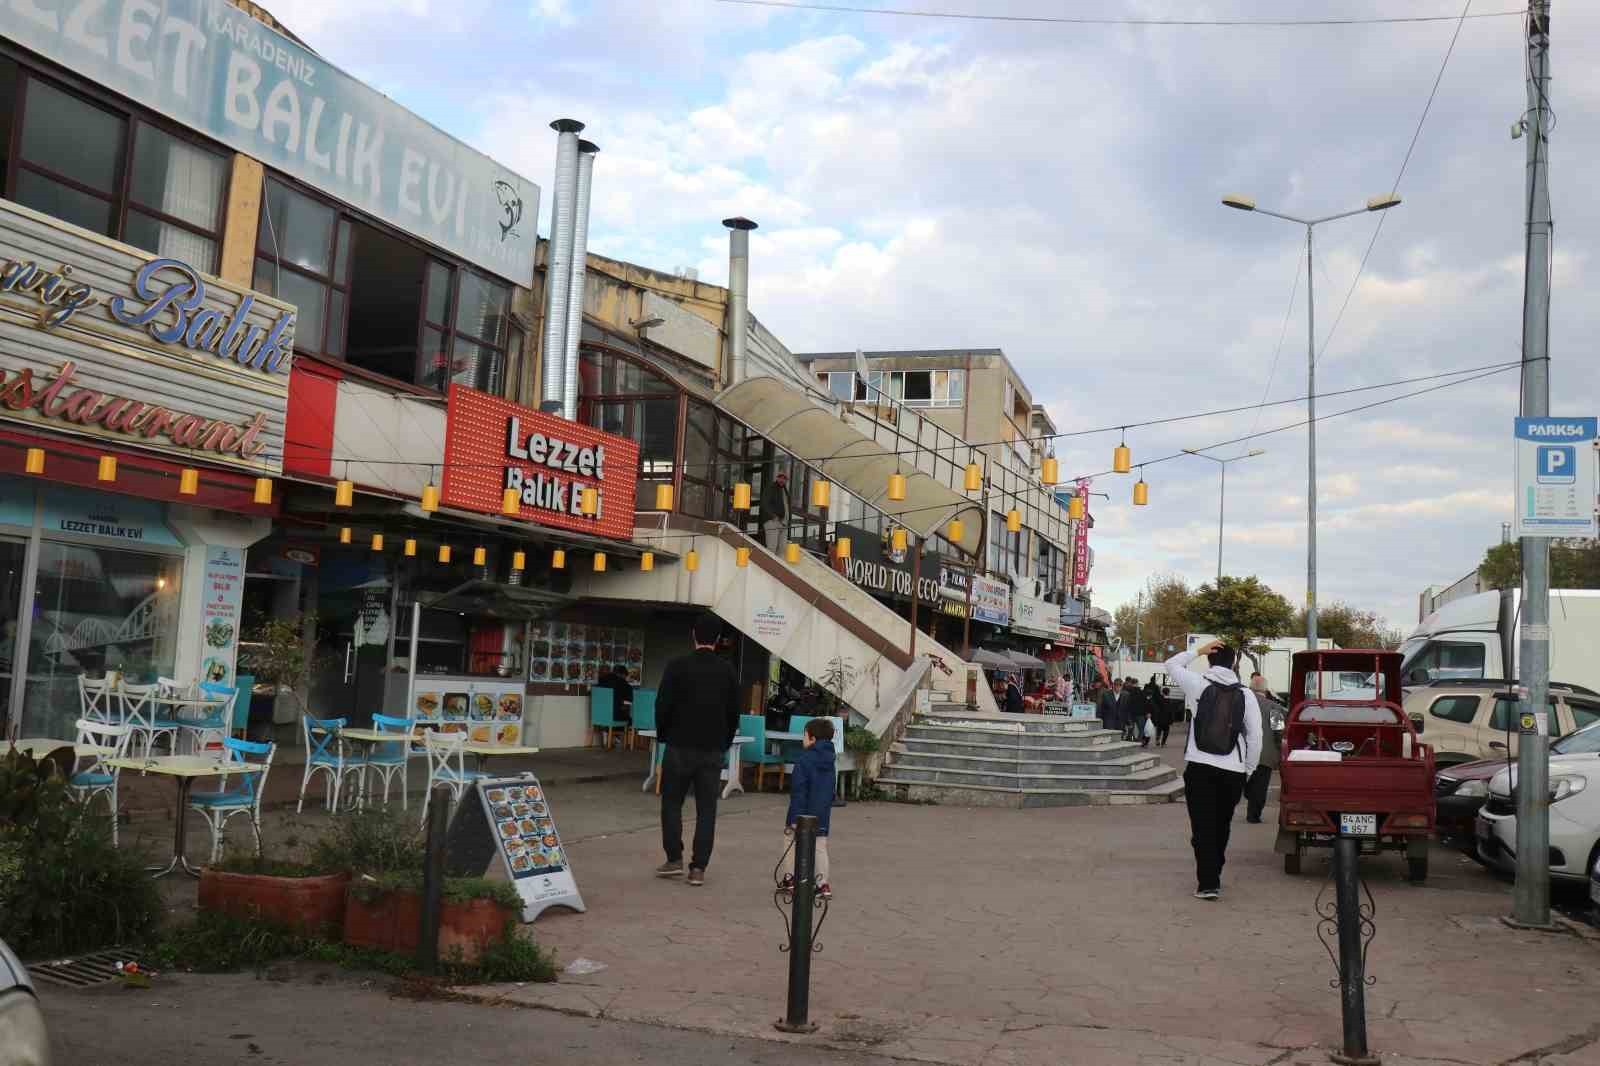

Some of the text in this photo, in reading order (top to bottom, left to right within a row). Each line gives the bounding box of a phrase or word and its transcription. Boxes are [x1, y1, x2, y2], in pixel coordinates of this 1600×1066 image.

[224, 50, 384, 198] BALIK
[1528, 424, 1585, 436] PARK54
[508, 415, 605, 480] Lezzet
[1547, 449, 1566, 473] P
[570, 481, 603, 520] Ei
[61, 519, 97, 534] LEZZET
[98, 524, 126, 537] BALIK
[843, 557, 938, 602] WORLD TOBCCO
[1343, 815, 1374, 824] 54 ANC
